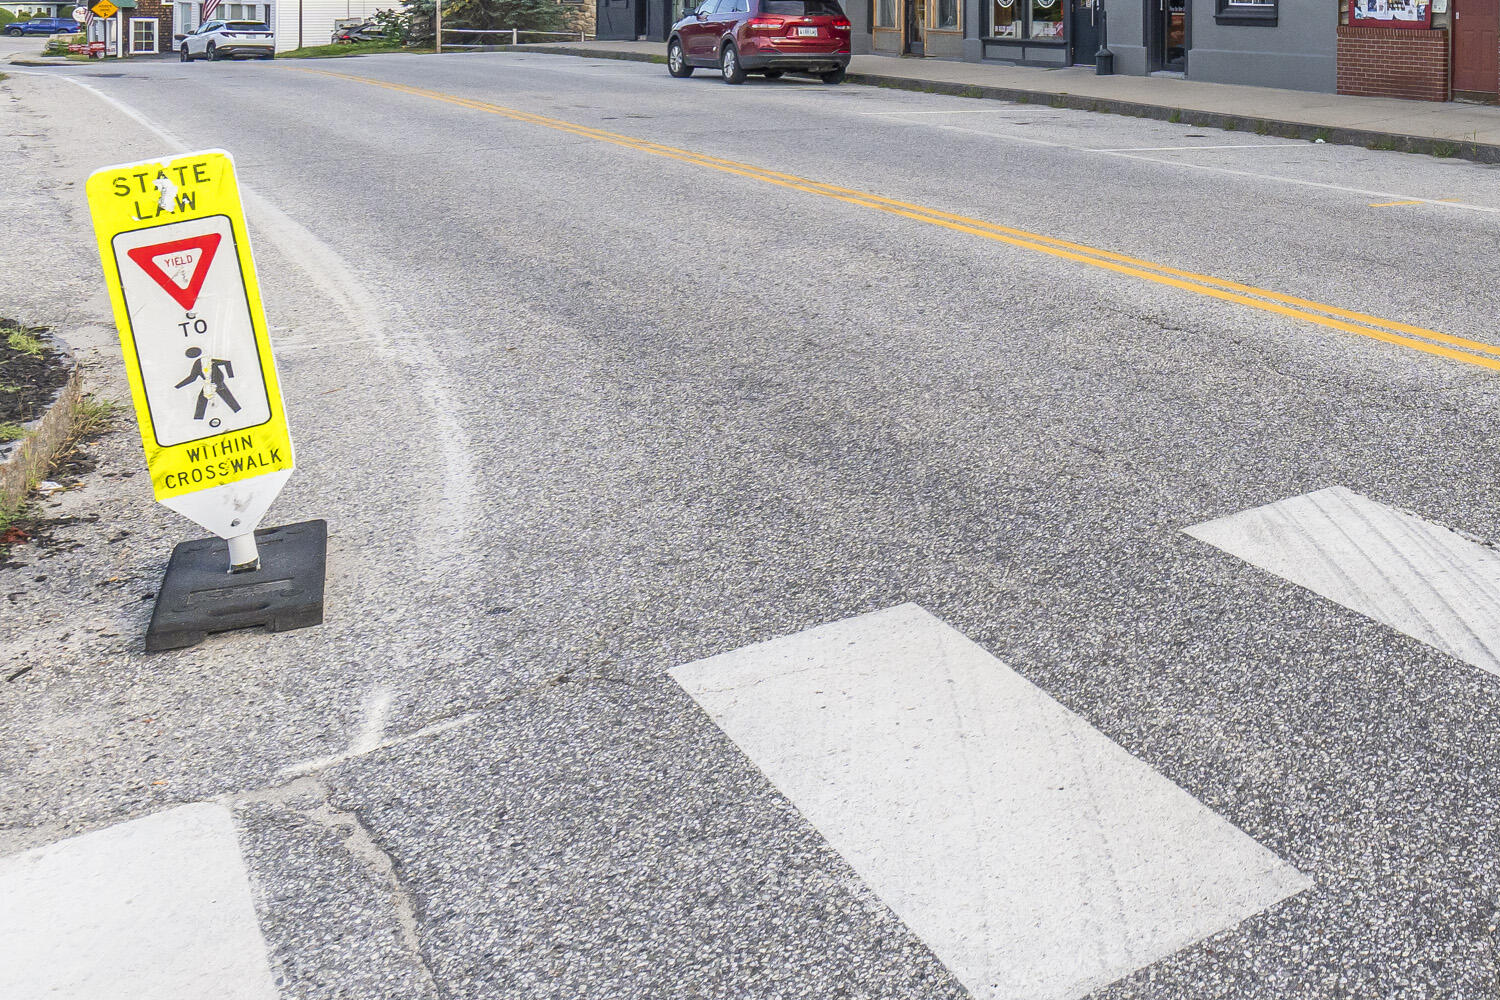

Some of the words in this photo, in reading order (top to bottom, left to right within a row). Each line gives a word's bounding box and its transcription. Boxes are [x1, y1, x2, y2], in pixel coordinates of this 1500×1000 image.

[113, 163, 211, 197] STATE
[134, 191, 196, 220] LAW
[164, 254, 193, 268] YIELD
[178, 319, 207, 338] TO
[187, 435, 253, 463] WITHIN
[165, 448, 282, 489] CROSSWALK
